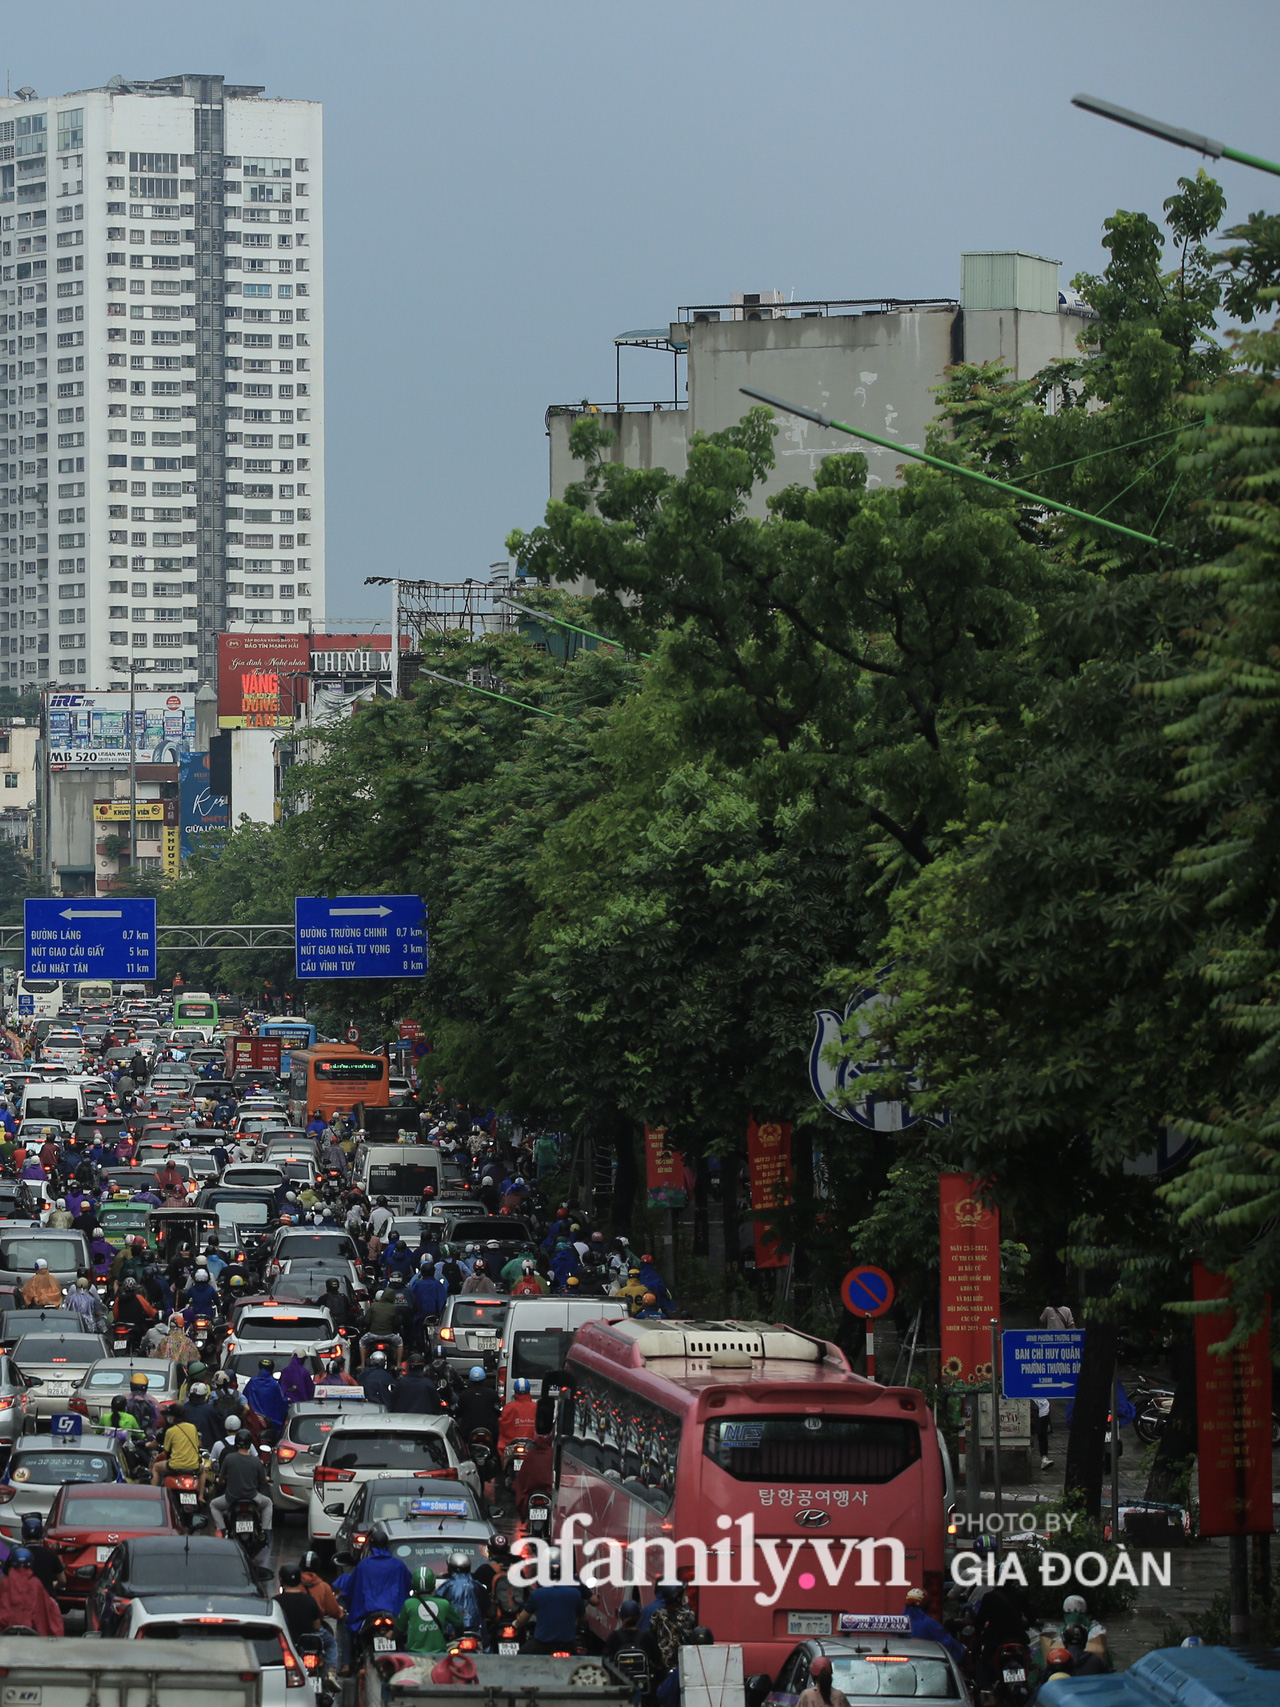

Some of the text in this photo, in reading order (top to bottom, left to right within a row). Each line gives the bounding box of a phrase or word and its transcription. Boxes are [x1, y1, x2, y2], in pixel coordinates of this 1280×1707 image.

[76, 752, 98, 762] 520
[31, 928, 149, 940] ĐƯỜNG LÁNG 0,7 km
[300, 925, 423, 938] ĐƯỜNG TRƯỜNG CHINH 0,7 km
[31, 944, 149, 956] NÚT GIAO CẦU GIẤY 5 km
[301, 943, 423, 956] NÚT GIAO NGÃ TƯ VỌNG 3 km
[31, 961, 149, 974] CẦU NHẬT TÂN 11 km
[301, 959, 423, 972] CẦU VĨNH TUY 8 km
[1015, 1344, 1080, 1360] BAN CHỈ HUY QUÂN
[1021, 1360, 1070, 1375] PHƯỜNG THƯỢNG
[58, 1416, 74, 1432] G7
[758, 1489, 868, 1507] 탑항공여행사
[431, 1500, 447, 1510] SÔNG
[448, 1500, 466, 1511] NHUỆ
[419, 1623, 438, 1632] Grab
